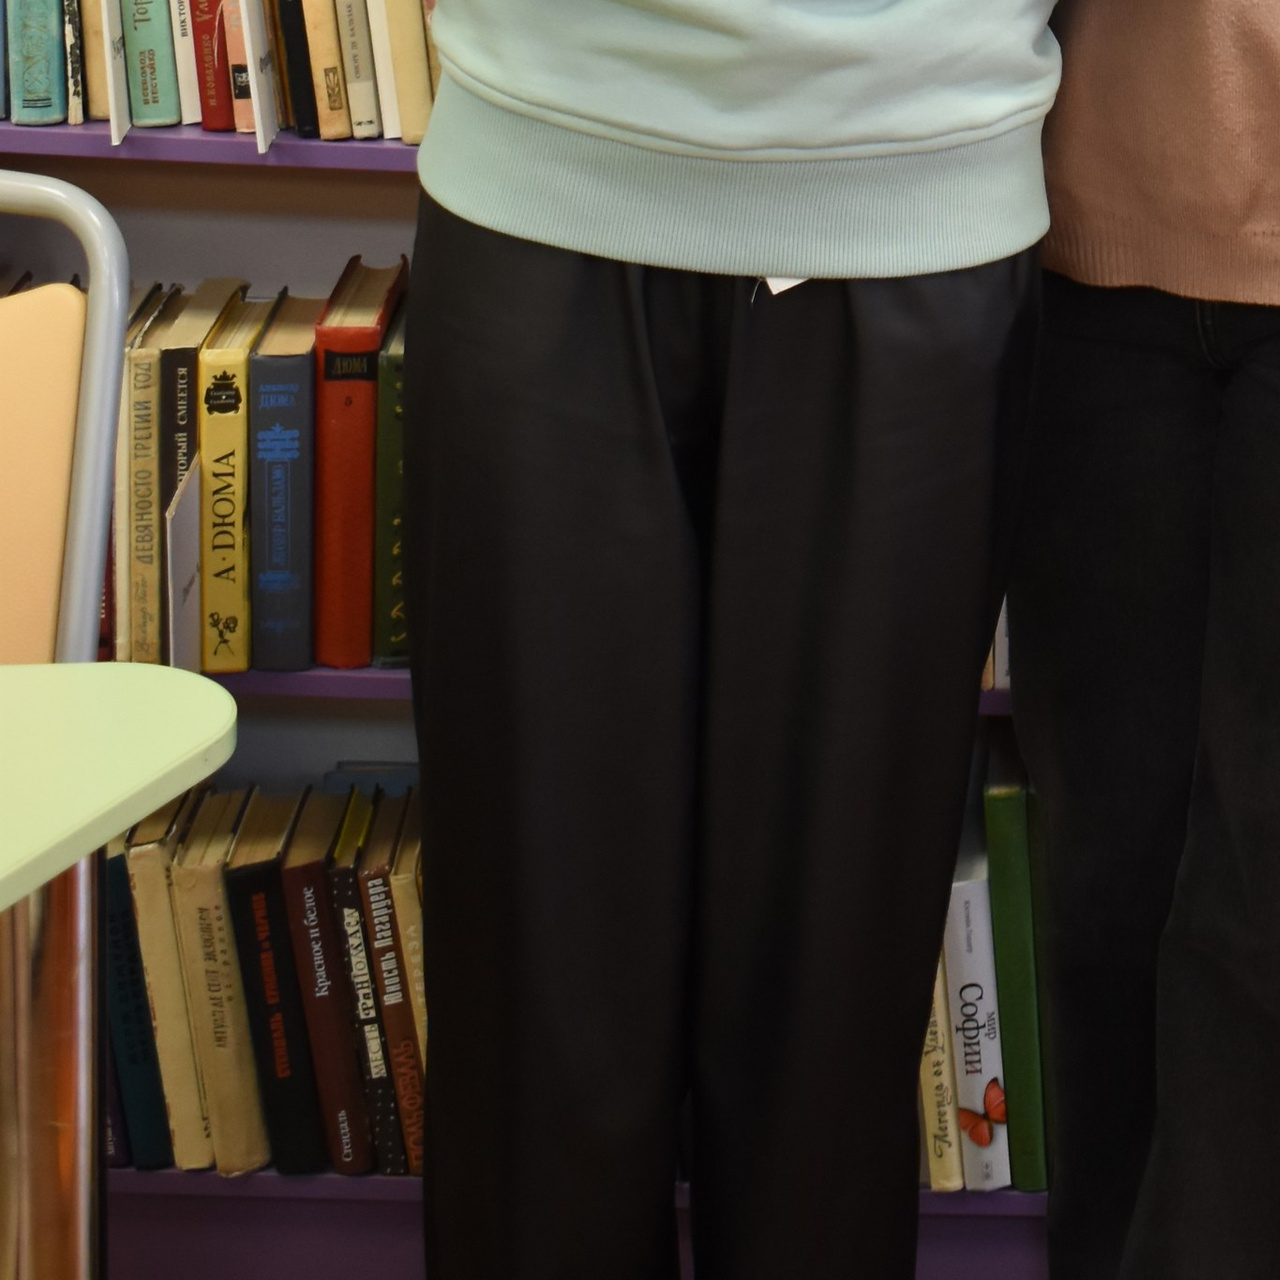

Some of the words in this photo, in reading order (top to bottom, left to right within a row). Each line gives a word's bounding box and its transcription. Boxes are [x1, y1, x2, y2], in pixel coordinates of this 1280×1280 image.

[131, 362, 152, 390] ГОД
[132, 400, 152, 460] ТРЕТИЙ
[133, 470, 153, 564] ДЕВЯНОСТО
[302, 887, 319, 926] белое
[308, 929, 320, 938] и
[309, 941, 329, 997] Красное
[955, 983, 983, 1075] Софии
[986, 1012, 998, 1039] мир
